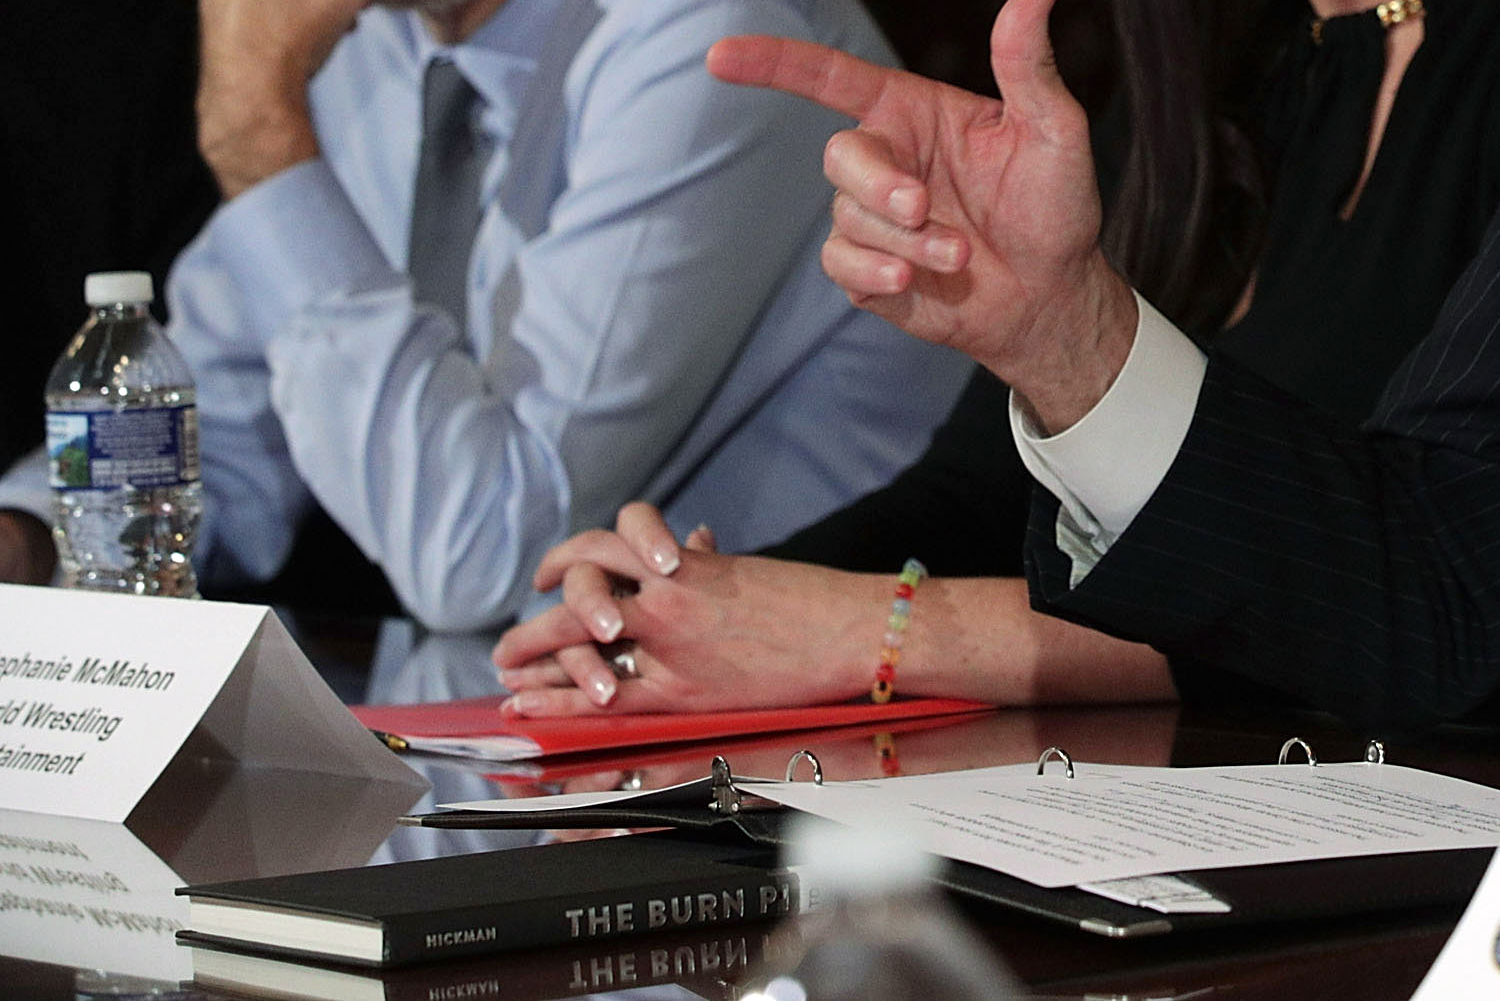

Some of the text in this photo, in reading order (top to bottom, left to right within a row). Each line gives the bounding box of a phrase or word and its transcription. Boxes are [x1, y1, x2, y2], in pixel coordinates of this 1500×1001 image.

[72, 657, 176, 691] McMahon
[22, 701, 123, 742] Wrestling
[565, 902, 634, 938] THE
[648, 888, 745, 930] BURN
[425, 926, 497, 949] HICKMAN
